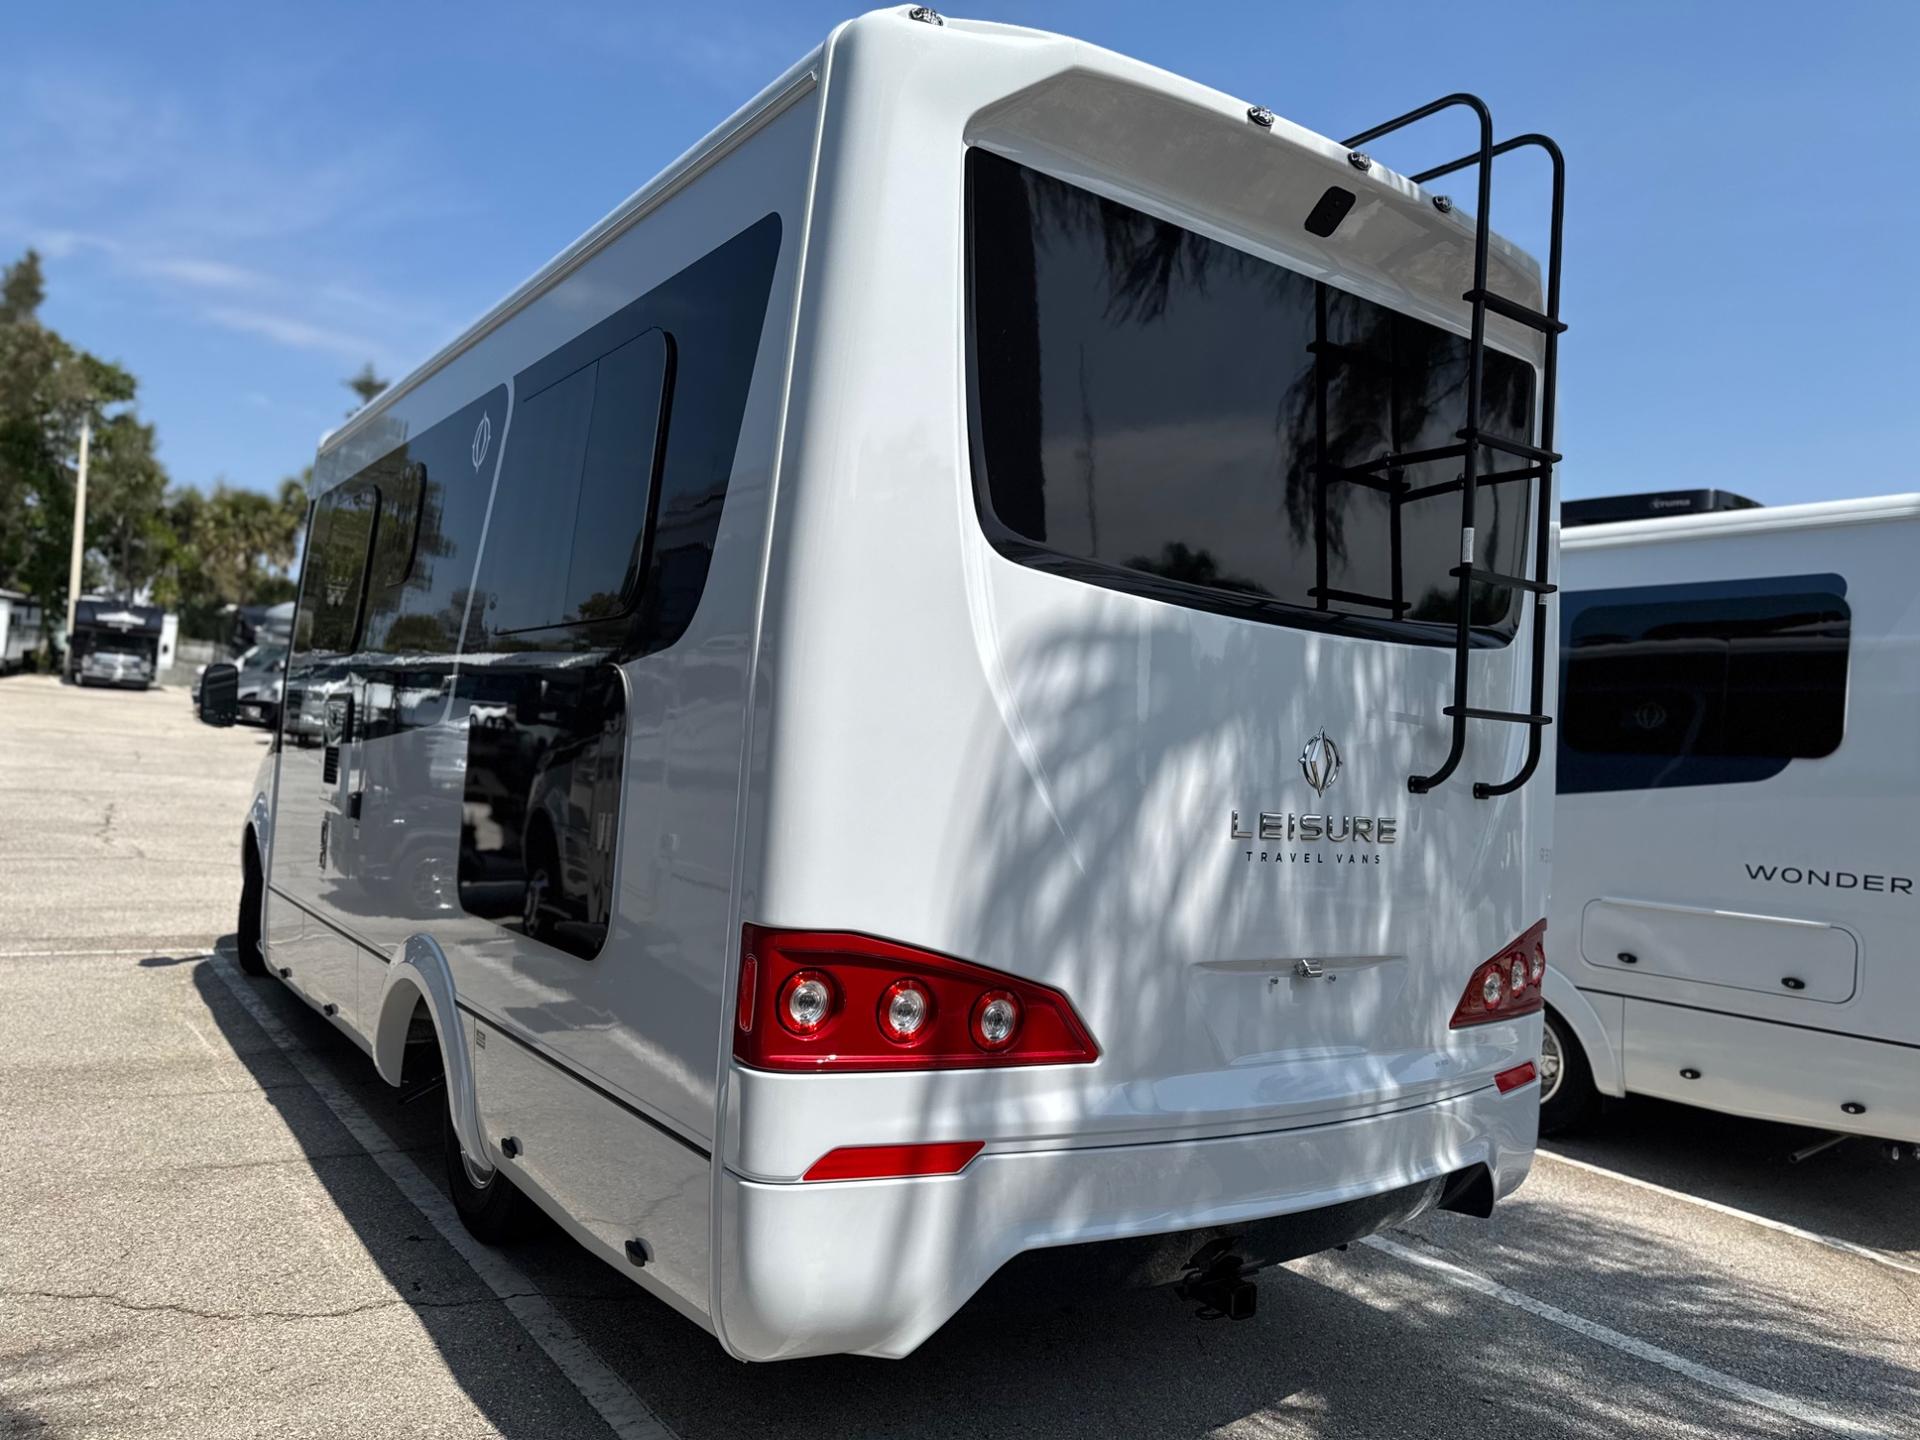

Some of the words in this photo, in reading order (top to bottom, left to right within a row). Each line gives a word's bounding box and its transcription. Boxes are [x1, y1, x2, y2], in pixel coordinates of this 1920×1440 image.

[1231, 810, 1397, 844] LEISURE
[1246, 851, 1323, 864] TRAVEL
[1336, 854, 1380, 865] VANS
[1745, 863, 1913, 895] WONDER
